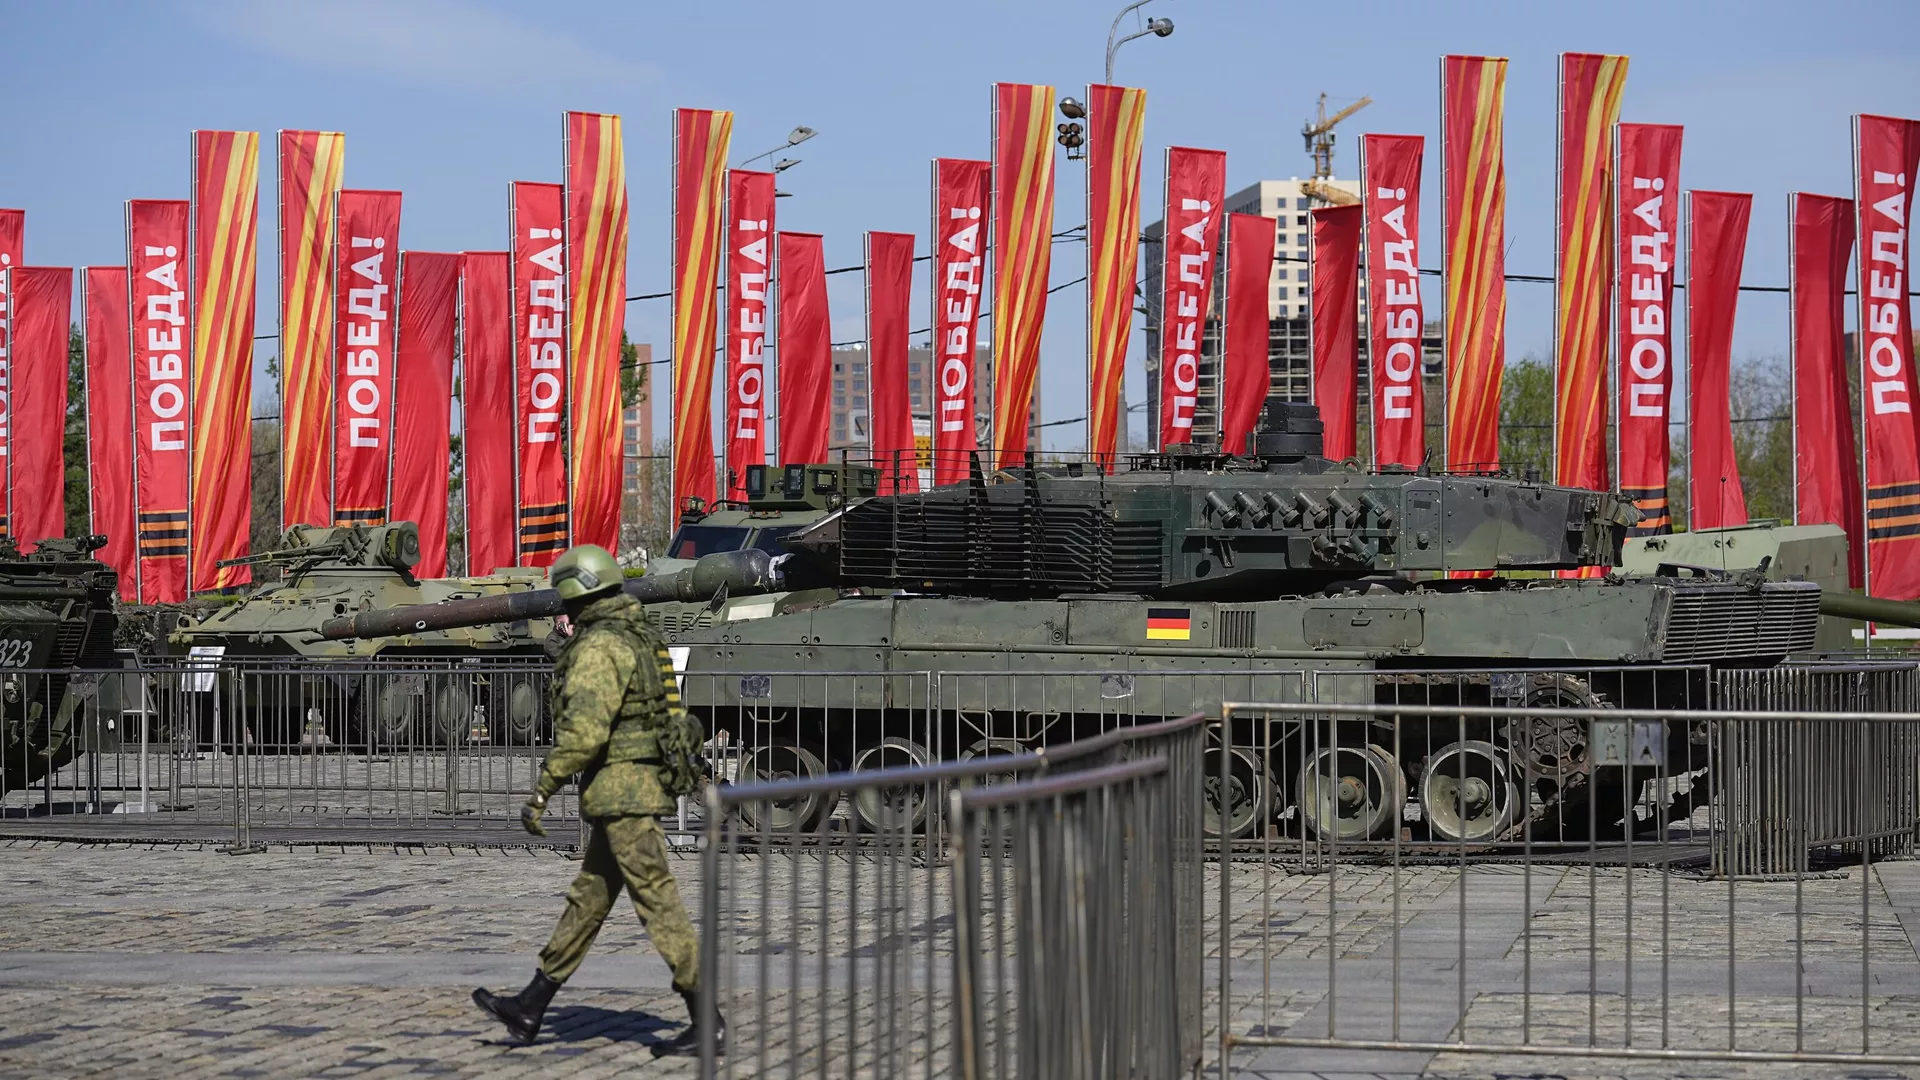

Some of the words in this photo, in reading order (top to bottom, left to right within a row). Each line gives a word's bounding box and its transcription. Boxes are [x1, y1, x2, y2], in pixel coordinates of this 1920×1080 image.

[146, 246, 185, 451] ПОБЕДА!
[347, 237, 388, 447] ПОБЕДА!
[528, 227, 566, 444] ПОБЕДА!
[736, 219, 768, 439] ПОБЕДА!
[941, 206, 981, 432] ПОБЕДА!
[1172, 198, 1212, 428] ПОБЕДА!
[1378, 187, 1419, 418] ПОБЕДА!
[1630, 178, 1668, 417] ПОБЕДА!
[1869, 171, 1910, 415] ПОБЕДА!
